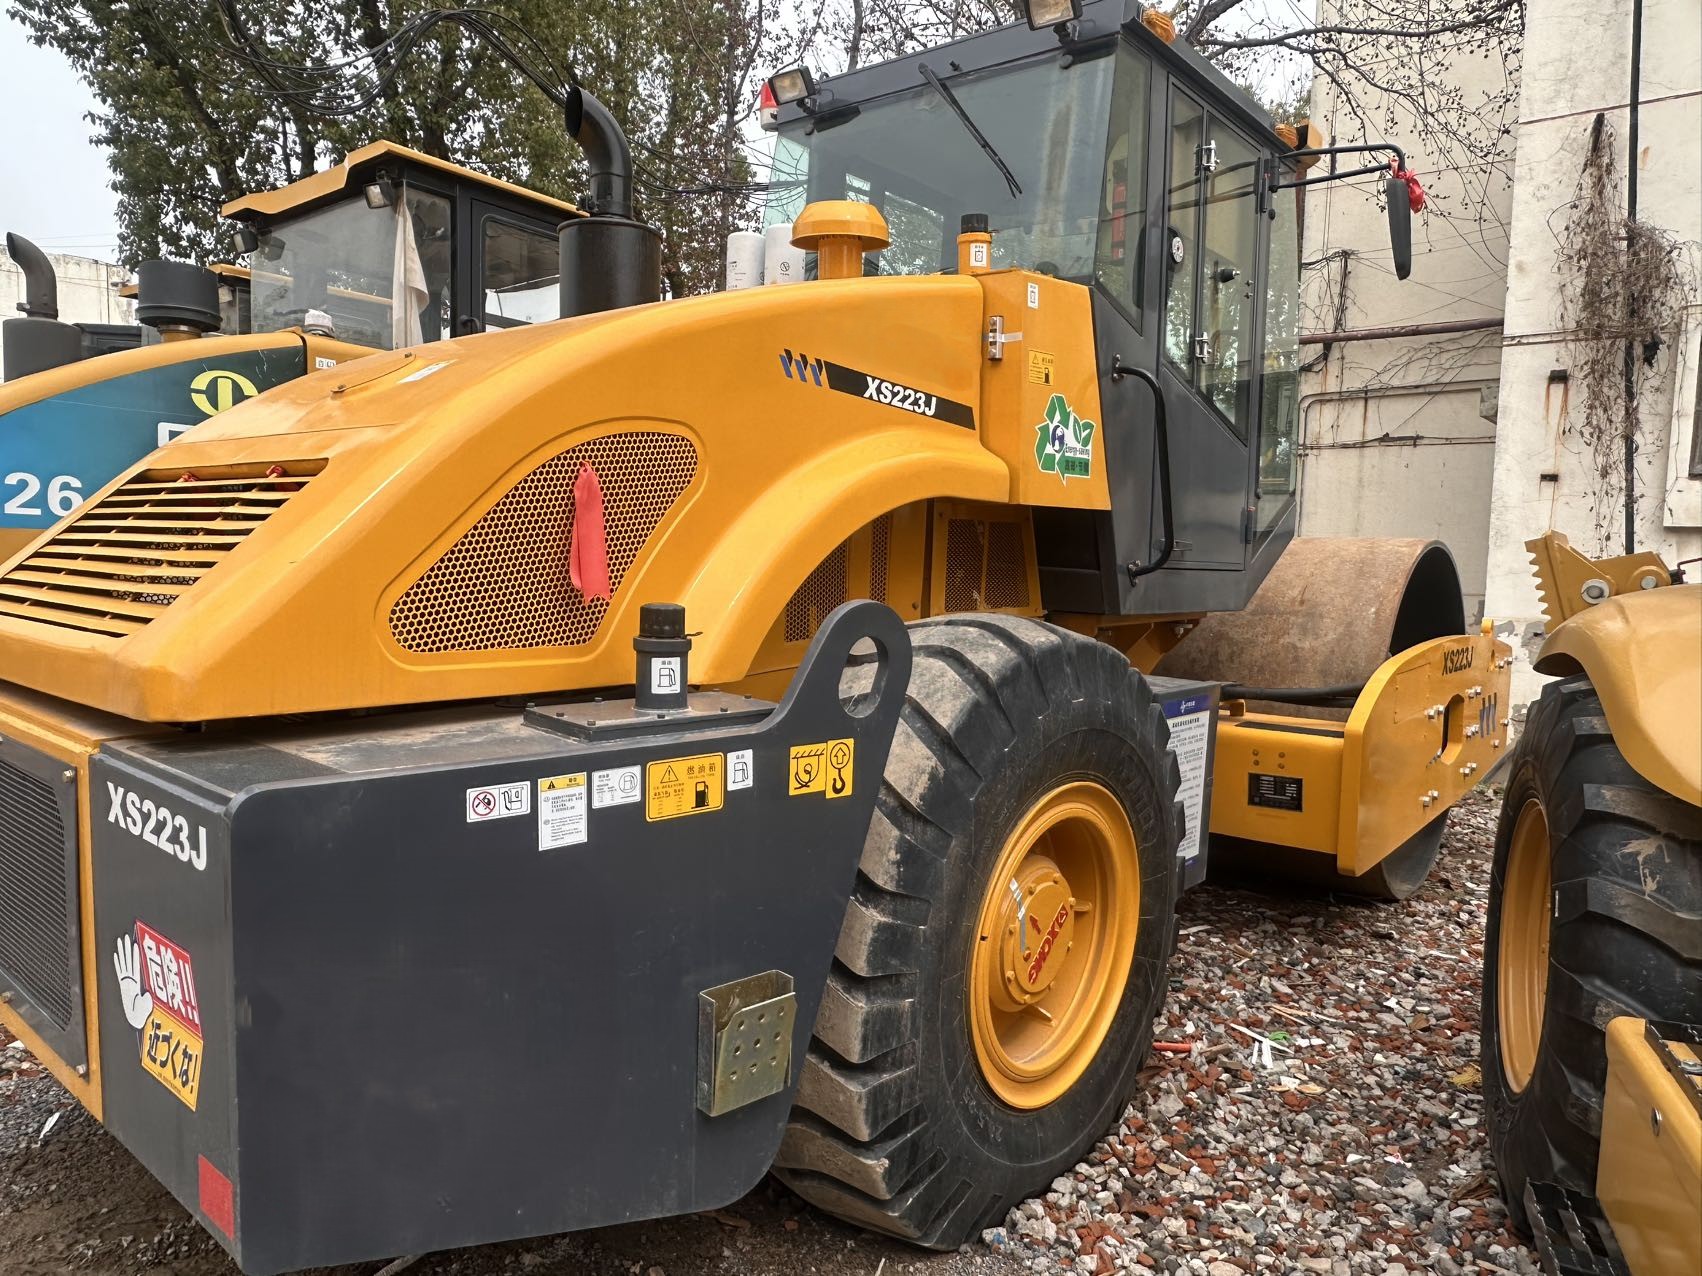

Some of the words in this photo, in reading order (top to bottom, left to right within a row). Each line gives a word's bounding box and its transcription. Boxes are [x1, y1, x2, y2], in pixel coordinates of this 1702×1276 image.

[863, 376, 938, 417] XS223J
[3, 472, 84, 517] 26
[1441, 646, 1474, 676] XS223J
[106, 781, 208, 872] XS223J
